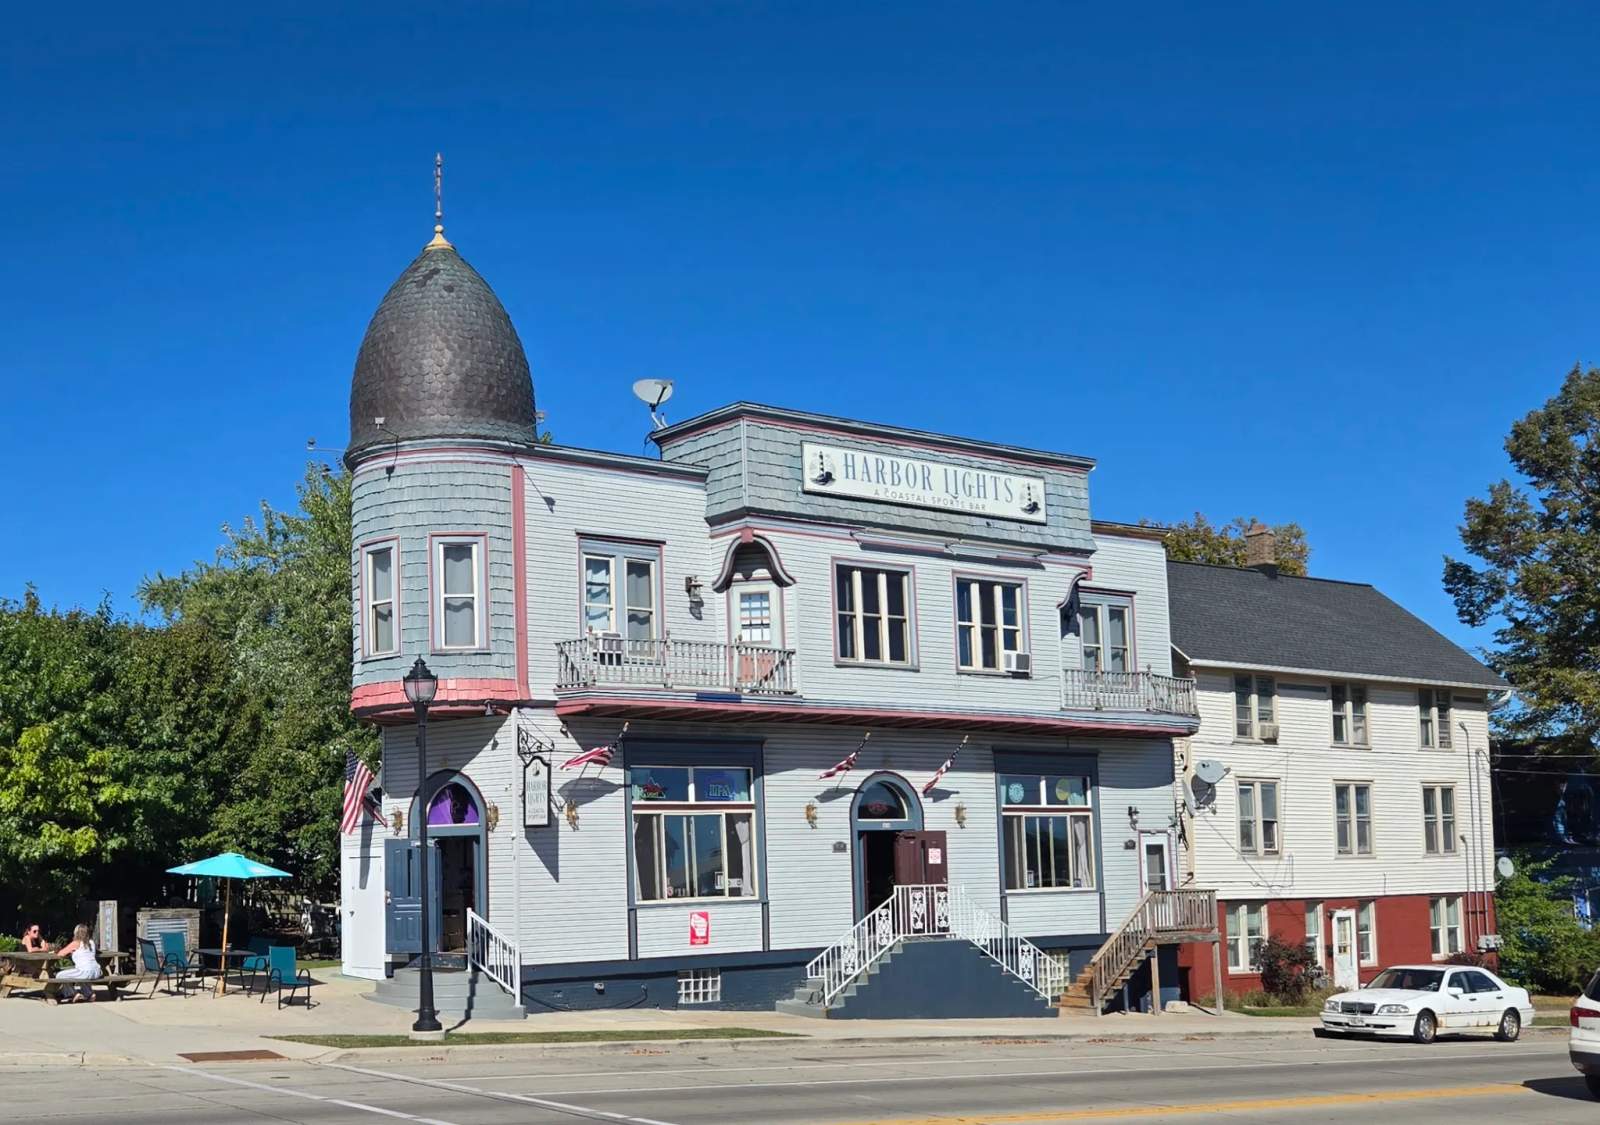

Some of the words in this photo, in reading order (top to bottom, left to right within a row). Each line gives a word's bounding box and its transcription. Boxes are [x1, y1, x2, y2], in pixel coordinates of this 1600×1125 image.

[844, 453, 933, 491] HARBOR
[944, 467, 1013, 503] LIGHTS
[874, 488, 880, 497] A
[885, 487, 926, 504] COASTAL
[932, 496, 965, 508] SPORTS
[969, 502, 986, 512] BAR
